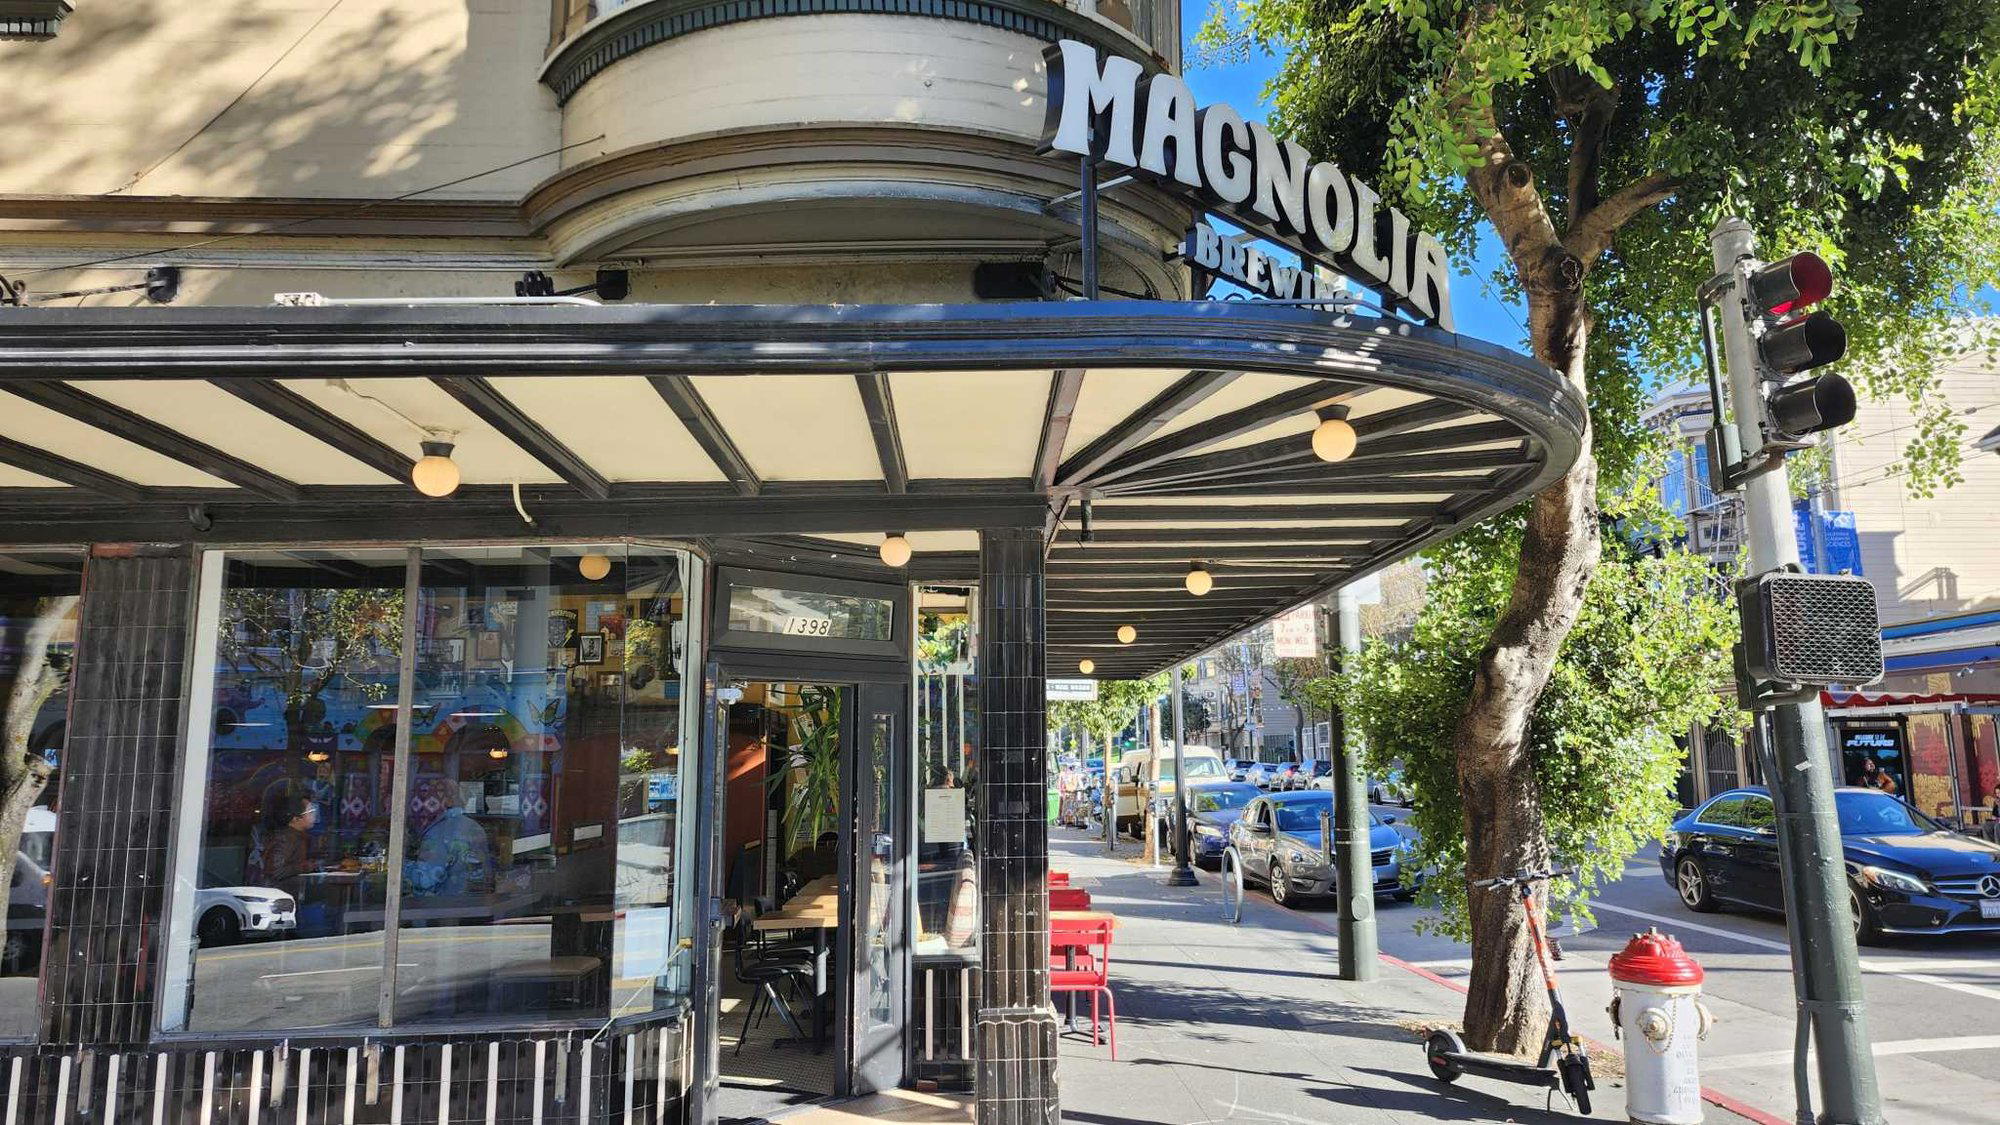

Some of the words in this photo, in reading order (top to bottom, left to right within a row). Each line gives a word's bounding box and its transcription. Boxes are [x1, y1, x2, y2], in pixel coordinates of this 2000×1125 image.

[1051, 38, 1455, 332] MAGNOLIA
[1194, 222, 1354, 313] BREWING
[788, 618, 829, 635] 1398
